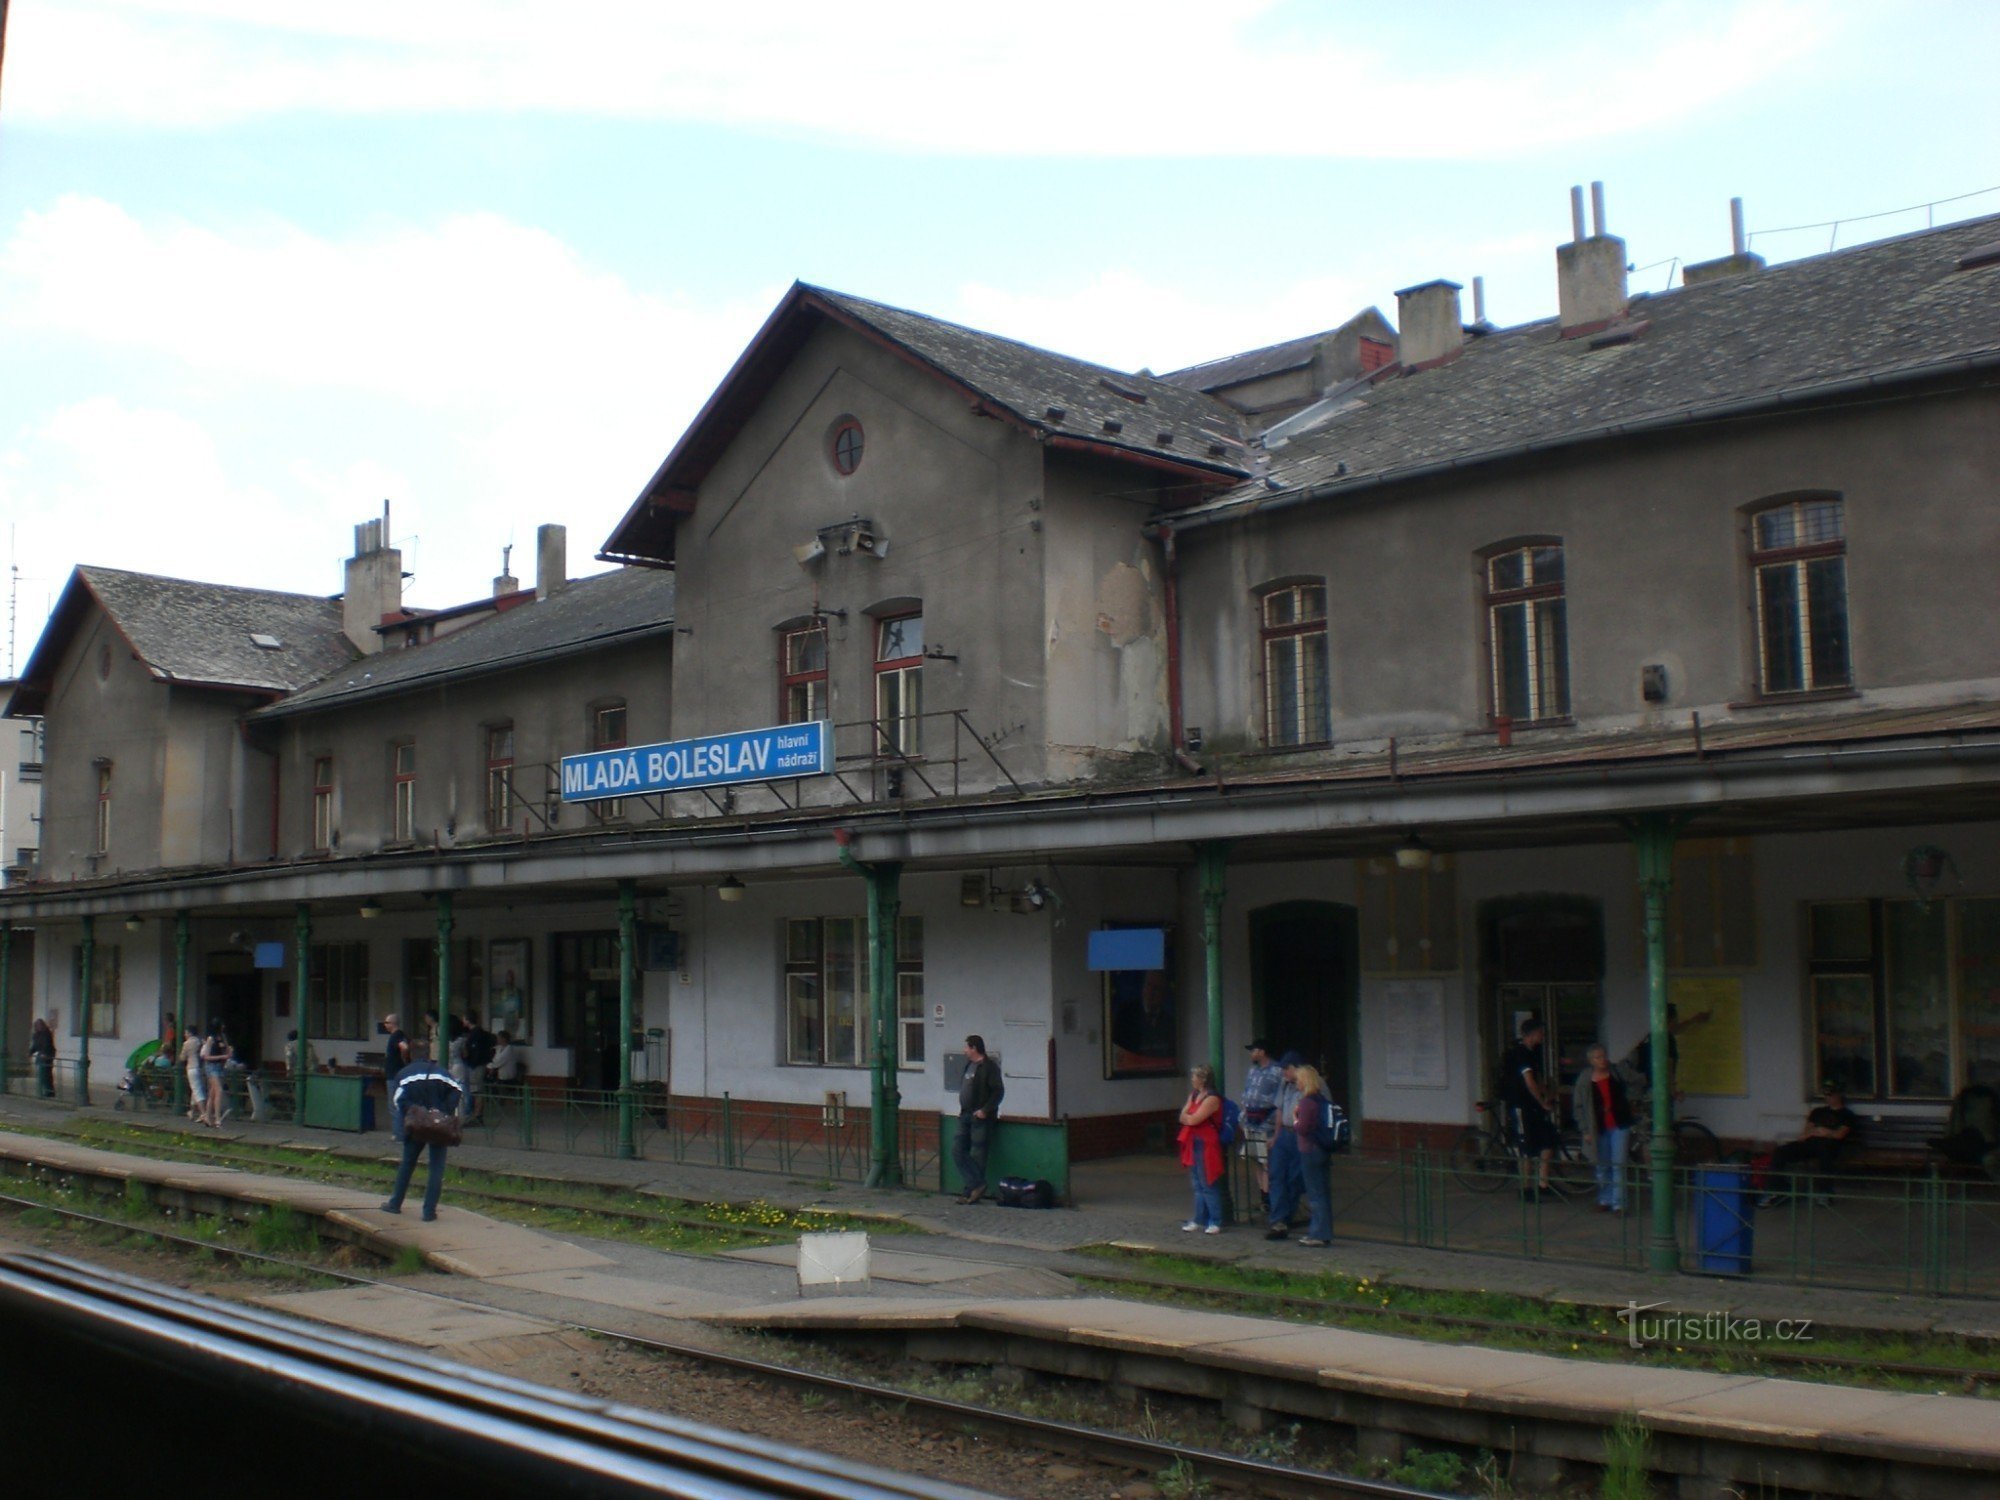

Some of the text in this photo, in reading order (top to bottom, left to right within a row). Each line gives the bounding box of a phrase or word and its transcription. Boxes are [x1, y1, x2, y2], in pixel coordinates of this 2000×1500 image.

[777, 733, 809, 749] hlavní
[564, 738, 771, 793] MLADÁ BOLESLAV
[777, 751, 817, 768] nádraží
